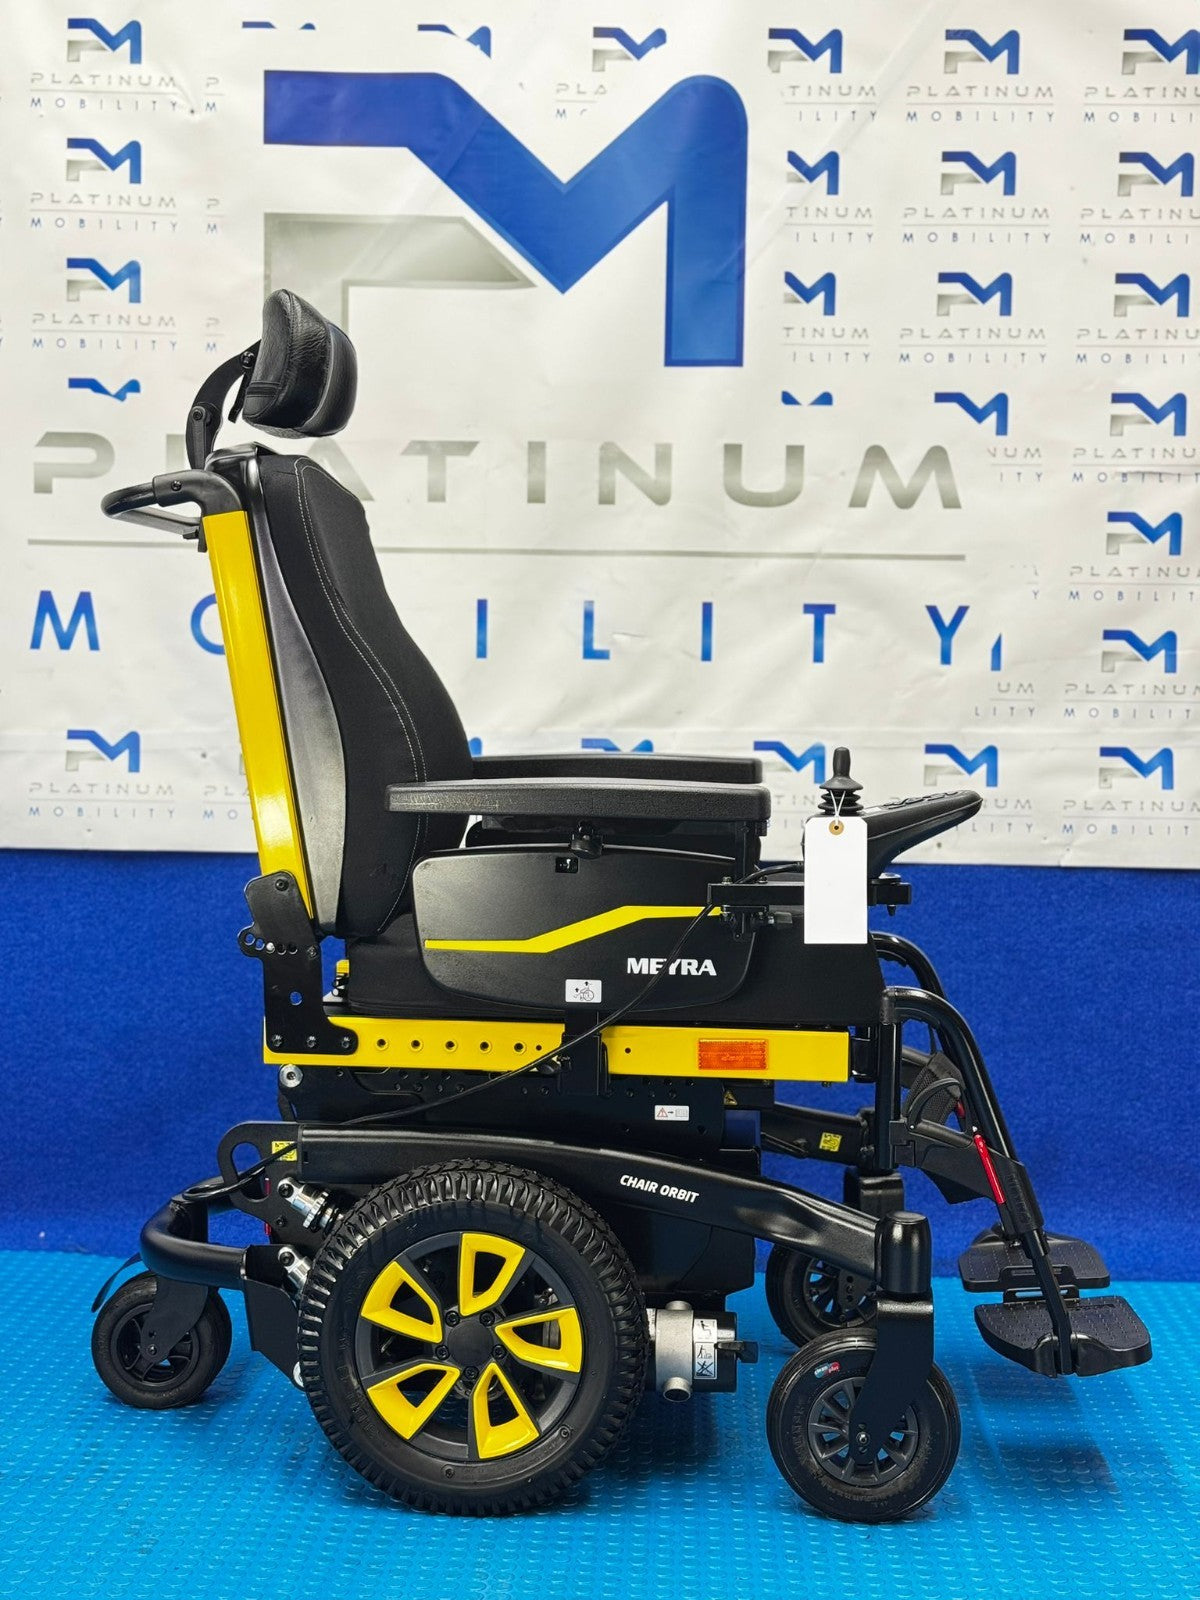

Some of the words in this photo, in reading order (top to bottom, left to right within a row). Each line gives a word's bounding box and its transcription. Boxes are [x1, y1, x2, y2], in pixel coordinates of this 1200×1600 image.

[30, 73, 177, 88] PLATINUM
[906, 86, 1054, 98] PLATINUM
[30, 98, 178, 111] MOBILITY
[906, 111, 1056, 123] MOBILITY
[30, 193, 177, 208] PLATINUM
[903, 207, 1050, 219] PLATINUM
[30, 218, 178, 231] MOBILITY
[902, 232, 1050, 244] MOBILITY
[32, 314, 176, 327] PLATINUM
[900, 327, 1046, 340] PLATINUM
[32, 339, 177, 350] MOBILITY
[899, 352, 1047, 364] MOBILITY
[1076, 353, 1200, 364] MOBILI
[1069, 566, 1200, 578] PLATINU
[30, 590, 970, 665] MILITY
[29, 783, 174, 795] PLATINUM
[29, 806, 175, 818] MOBILITY
[627, 957, 717, 977] MEYRA
[620, 1175, 659, 1193] CHAIR
[660, 1185, 700, 1203] ORBIT
